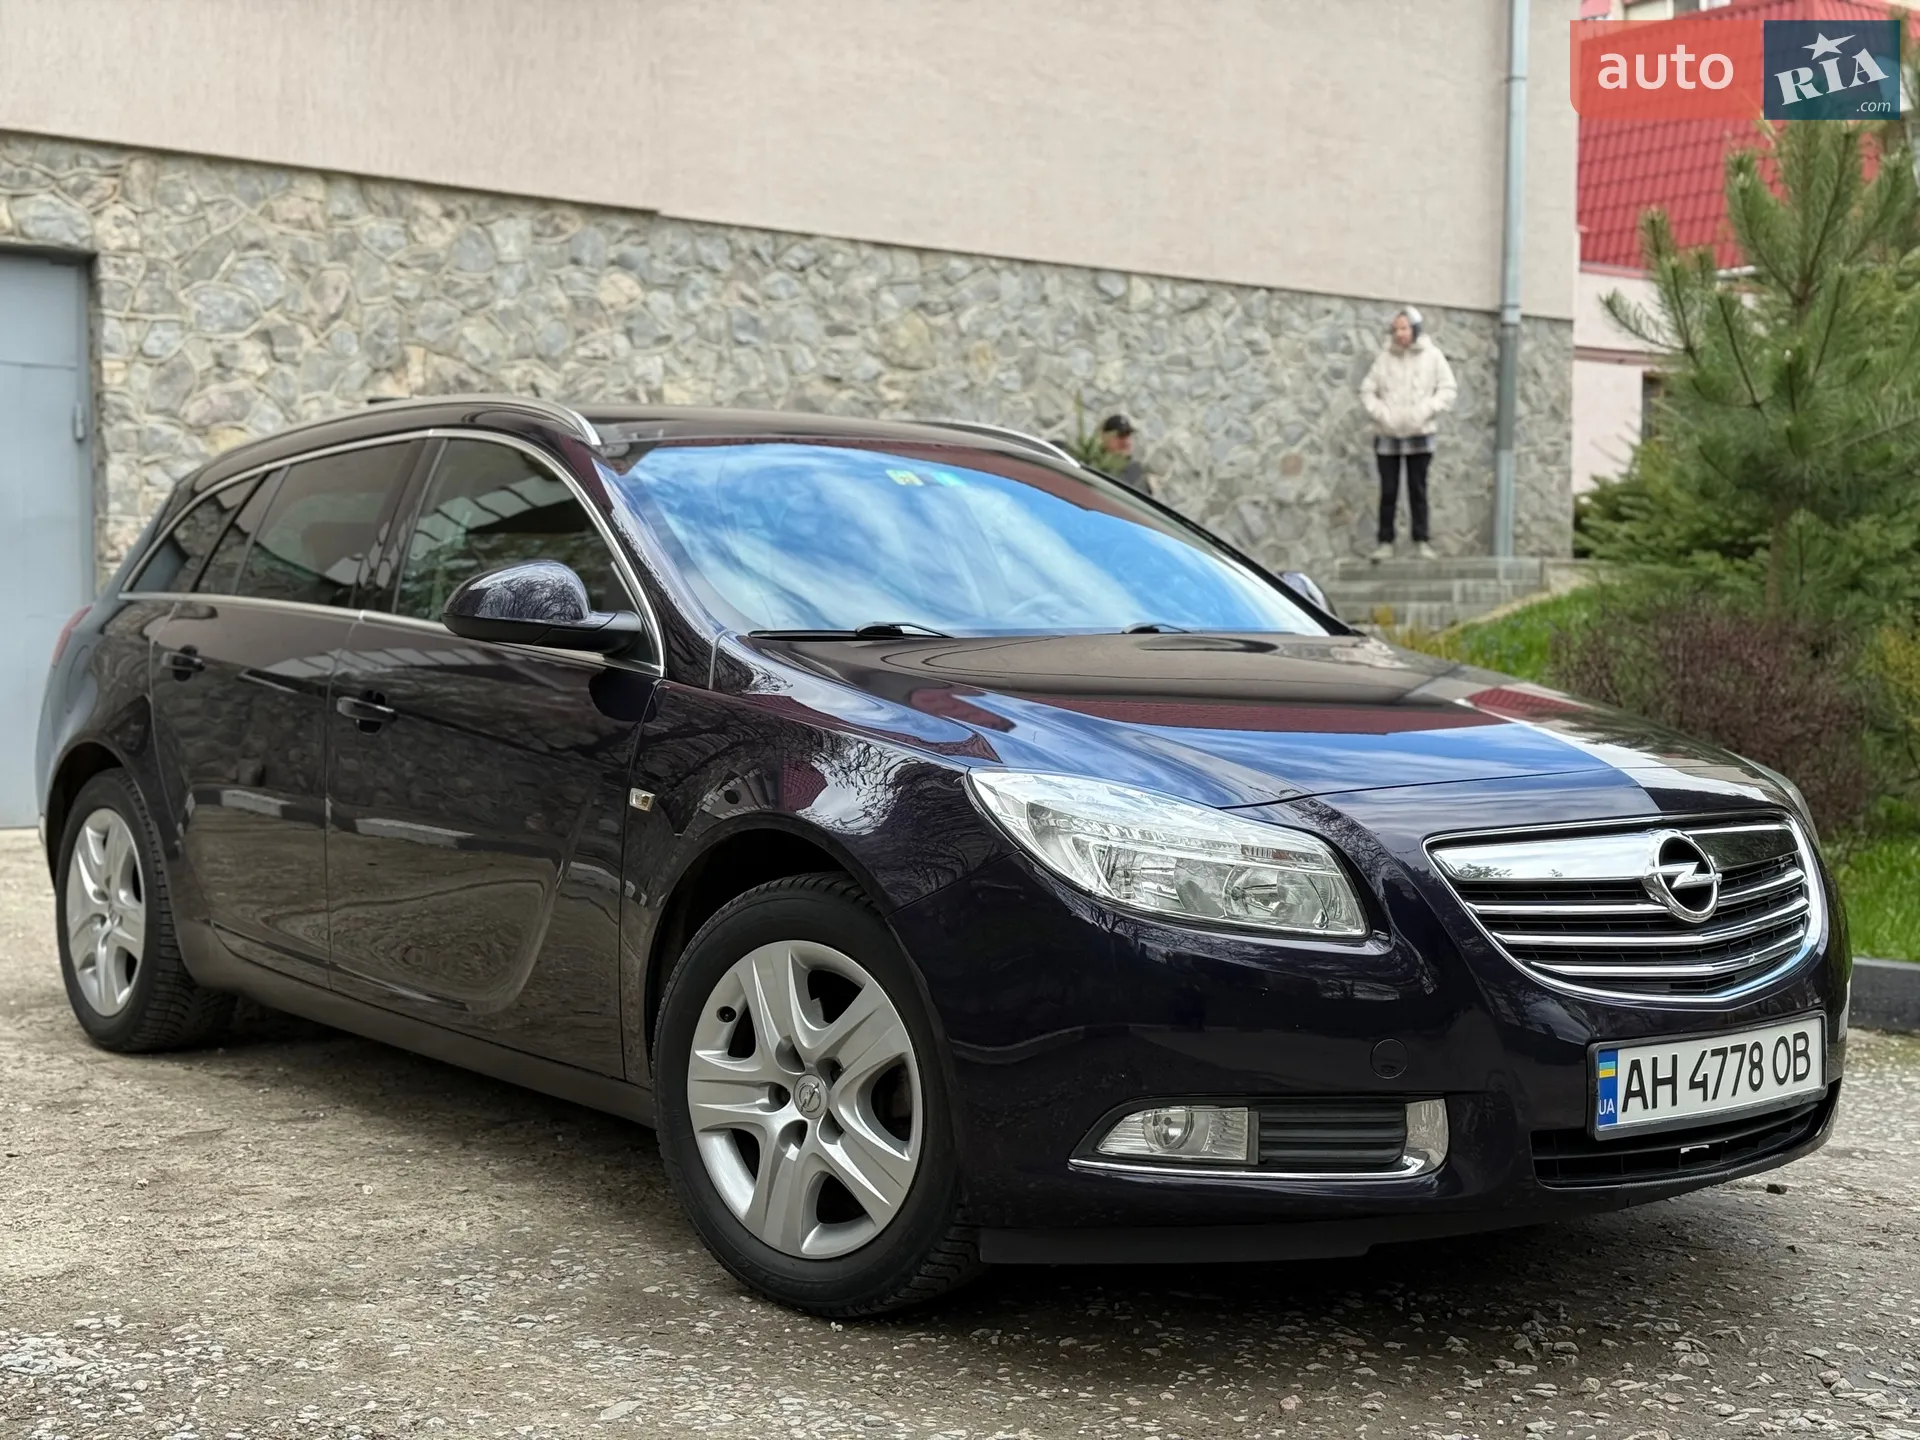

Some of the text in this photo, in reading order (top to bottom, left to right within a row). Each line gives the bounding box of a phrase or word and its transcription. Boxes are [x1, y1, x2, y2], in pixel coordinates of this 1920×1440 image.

[1621, 1031, 1812, 1112] AH 4778 OB
[1598, 1098, 1615, 1116] UA
